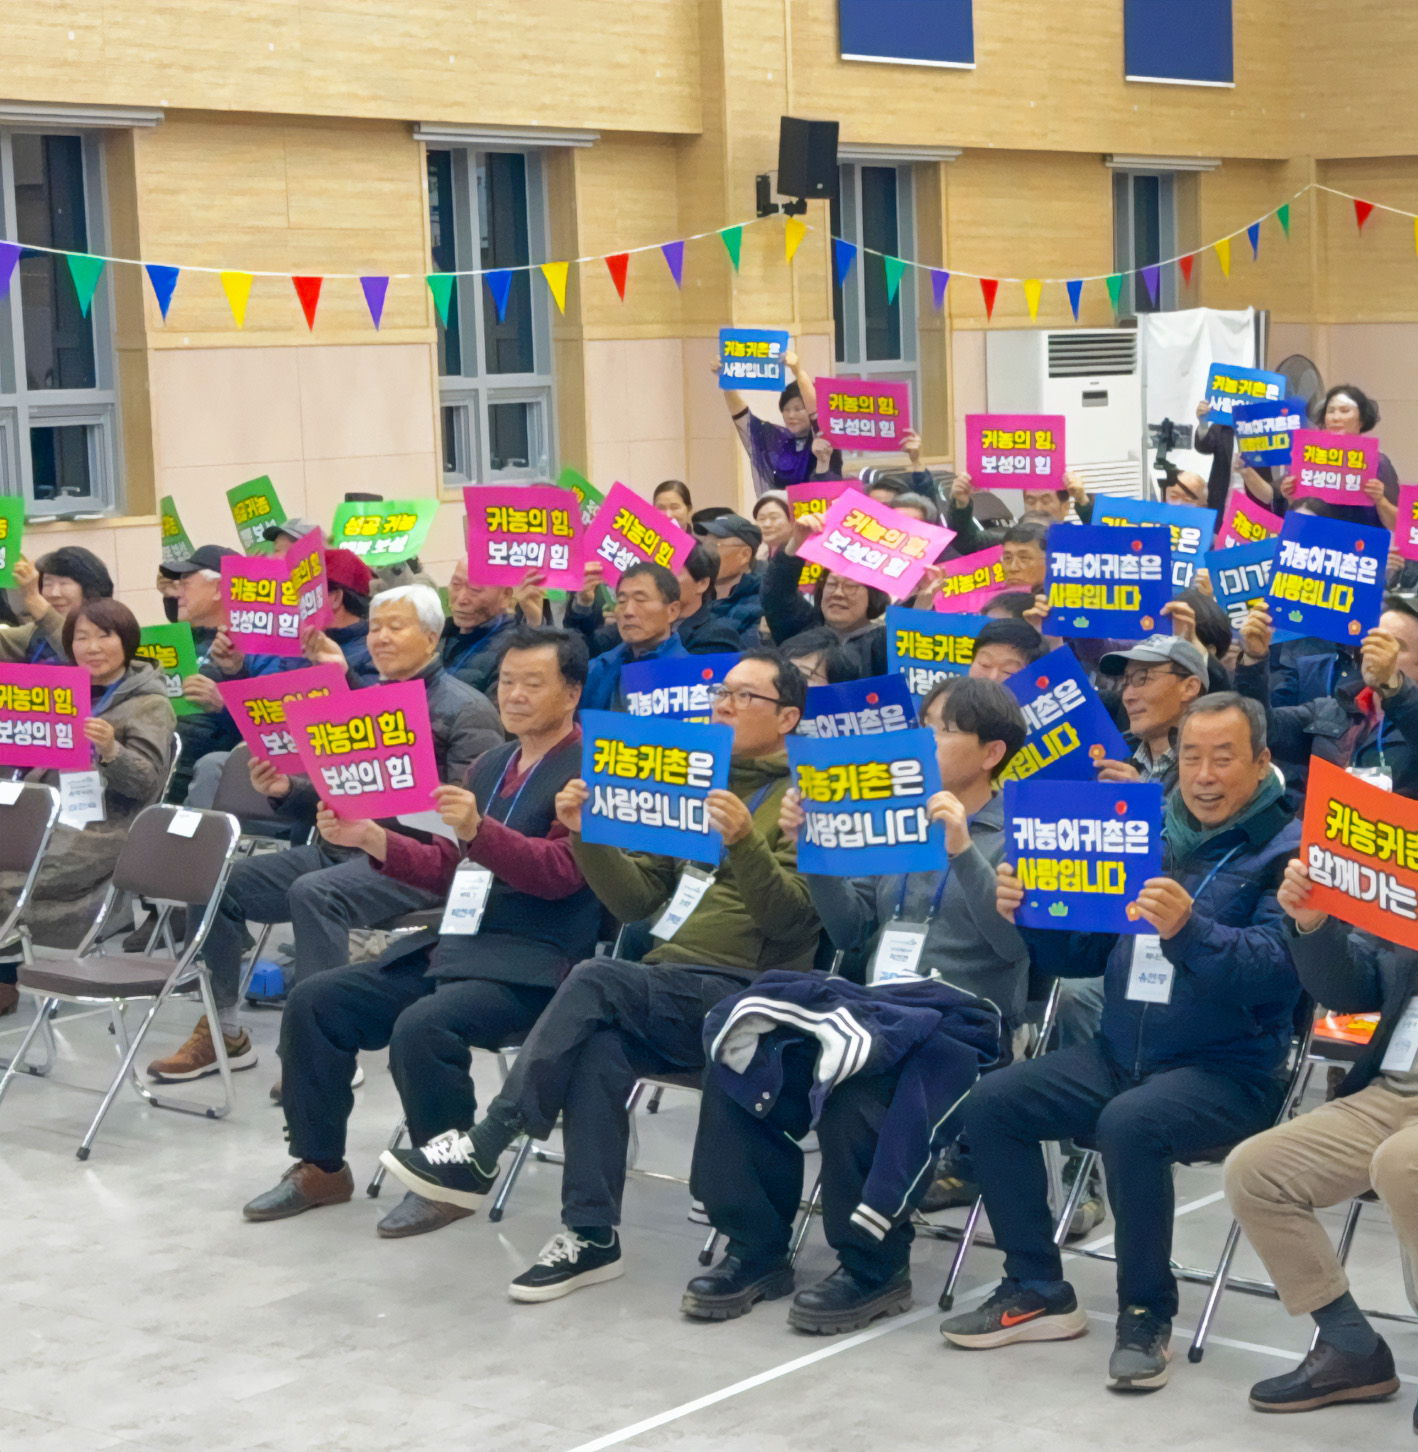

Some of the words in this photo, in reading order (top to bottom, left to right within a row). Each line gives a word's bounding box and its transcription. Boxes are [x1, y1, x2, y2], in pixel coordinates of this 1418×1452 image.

[828, 393, 874, 414] 귀농의
[829, 417, 875, 437] 보성의
[878, 419, 896, 438] 힘
[981, 429, 1032, 449] 귀농의
[1035, 430, 1057, 451] 힘,
[981, 456, 1031, 474] 보성의
[1034, 456, 1051, 474] 힘
[1303, 445, 1344, 467] 귀농의
[1300, 468, 1341, 490] 보성의
[1345, 473, 1362, 492] 힘
[486, 506, 547, 535] 귀농의
[550, 510, 576, 539] 힘,
[612, 507, 661, 557] 귀농의
[487, 540, 546, 568] 보성의
[550, 543, 569, 570] 힘
[823, 529, 888, 571] 보성의
[1051, 552, 1163, 581] 귀농어귀촌은
[1279, 540, 1379, 586] 귀농어귀촌은
[942, 569, 991, 599] 귀농의
[1048, 582, 1142, 612] 사랑입니다
[1268, 571, 1355, 614] 사랑입니다
[229, 610, 273, 636] 보성의
[278, 612, 300, 638] 힘
[895, 629, 976, 665] 귀농귀촌
[0, 683, 50, 713] 귀농의
[53, 686, 79, 717] 힘,
[0, 719, 51, 748] 보성의
[55, 722, 74, 749] 힘
[305, 715, 377, 757] 귀농의
[376, 709, 416, 747] 힘,
[320, 759, 385, 796] 보성의
[385, 754, 415, 791] 힘
[593, 738, 715, 788] 귀농귀촌은
[796, 758, 925, 803] 귀농귀촌은
[591, 789, 710, 834] 사랑입니다
[805, 806, 930, 849] 사랑입니다
[1012, 817, 1150, 855] 귀농어귀촌은
[1017, 857, 1127, 896] 사랑입니다
[1307, 844, 1418, 922] 함께가는
